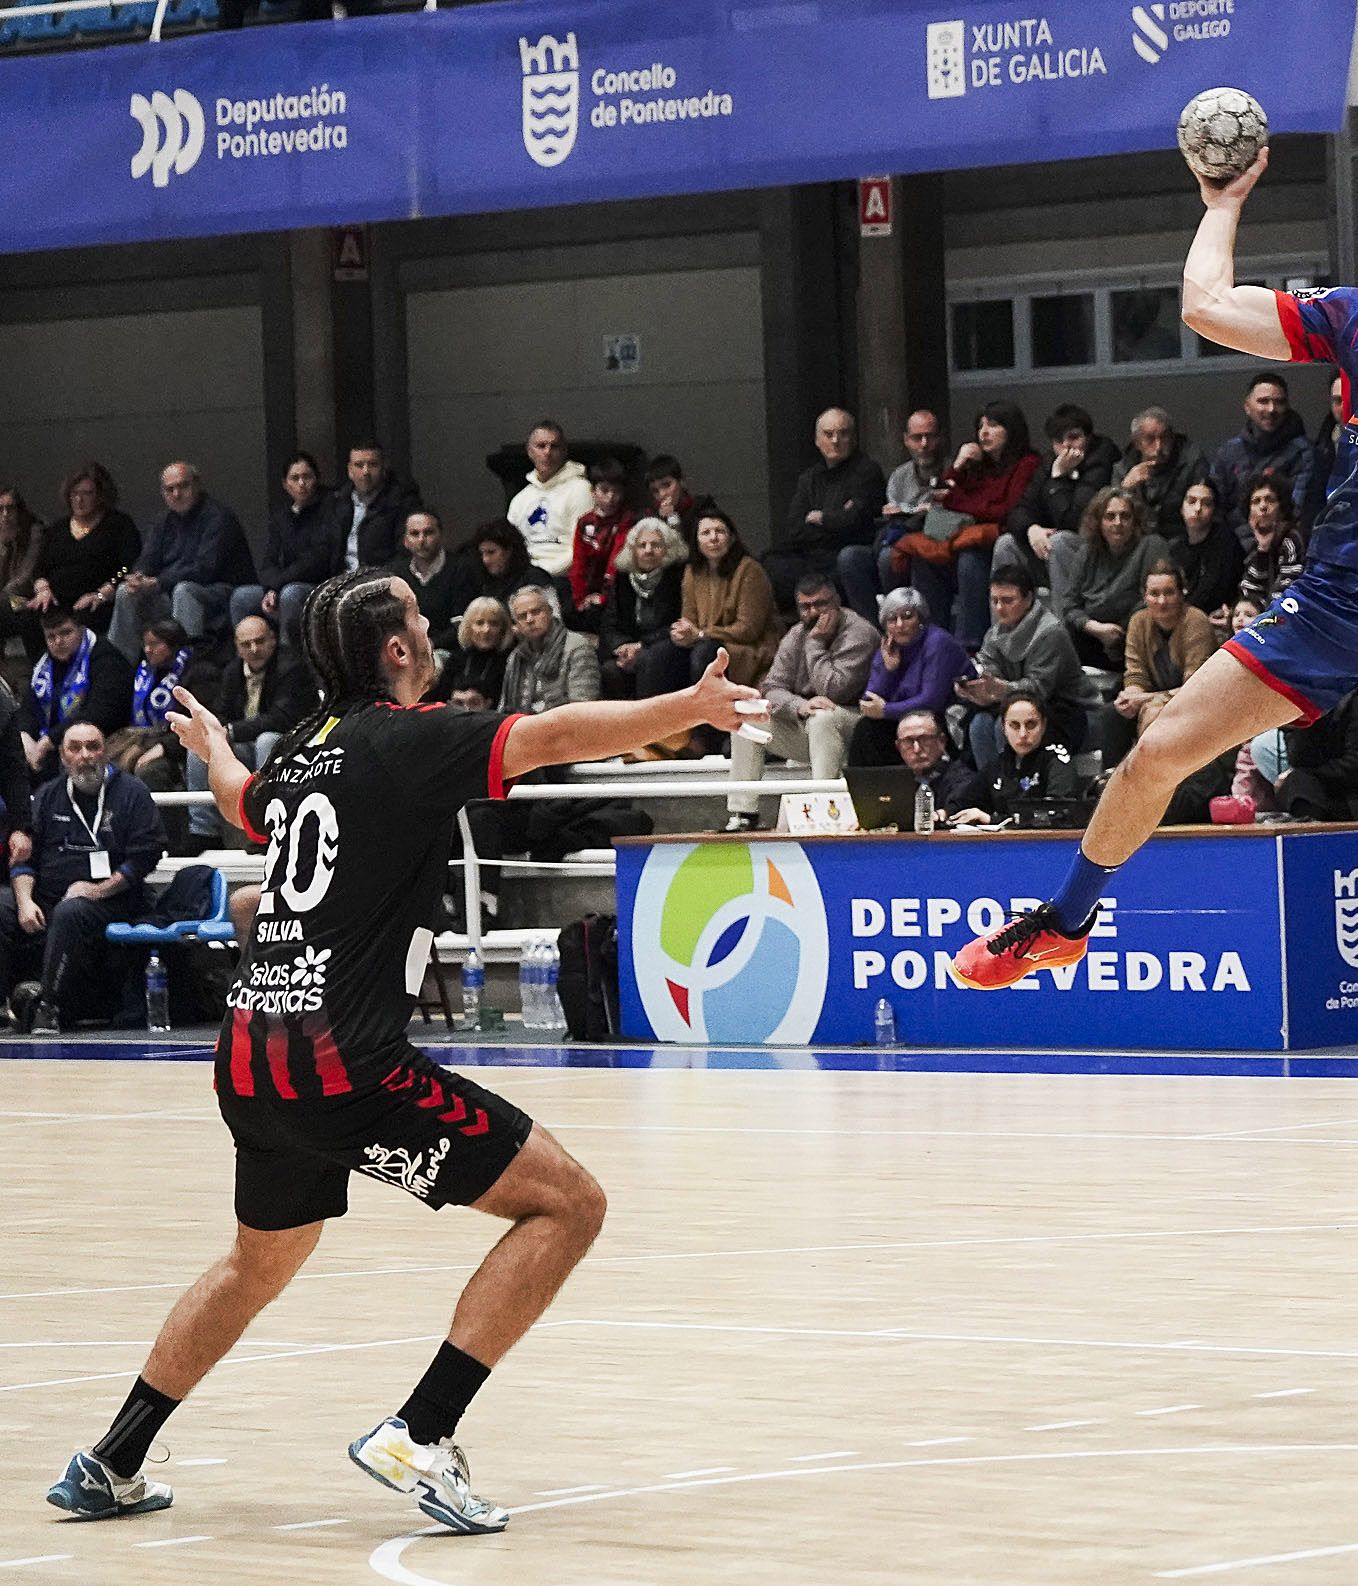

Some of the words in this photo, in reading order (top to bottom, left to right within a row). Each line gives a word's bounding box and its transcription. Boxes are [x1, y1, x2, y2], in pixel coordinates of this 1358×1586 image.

[1169, 0, 1234, 20] DEPORTE
[972, 18, 1053, 53] XUNTA
[1173, 19, 1231, 41] GALEGO
[591, 63, 677, 96] Concello
[971, 57, 1002, 87] DE
[1009, 47, 1108, 84] GALICIA
[216, 84, 346, 130] Deputación
[591, 102, 615, 127] de
[620, 89, 733, 125] Pontevedra
[217, 122, 348, 159] Pontevedra
[865, 186, 886, 219] A
[256, 792, 339, 916] 20
[256, 919, 305, 944] SILVA
[851, 897, 1118, 938] DEPOE
[854, 950, 1251, 993] PONVEDRA
[1326, 998, 1340, 1010] de
